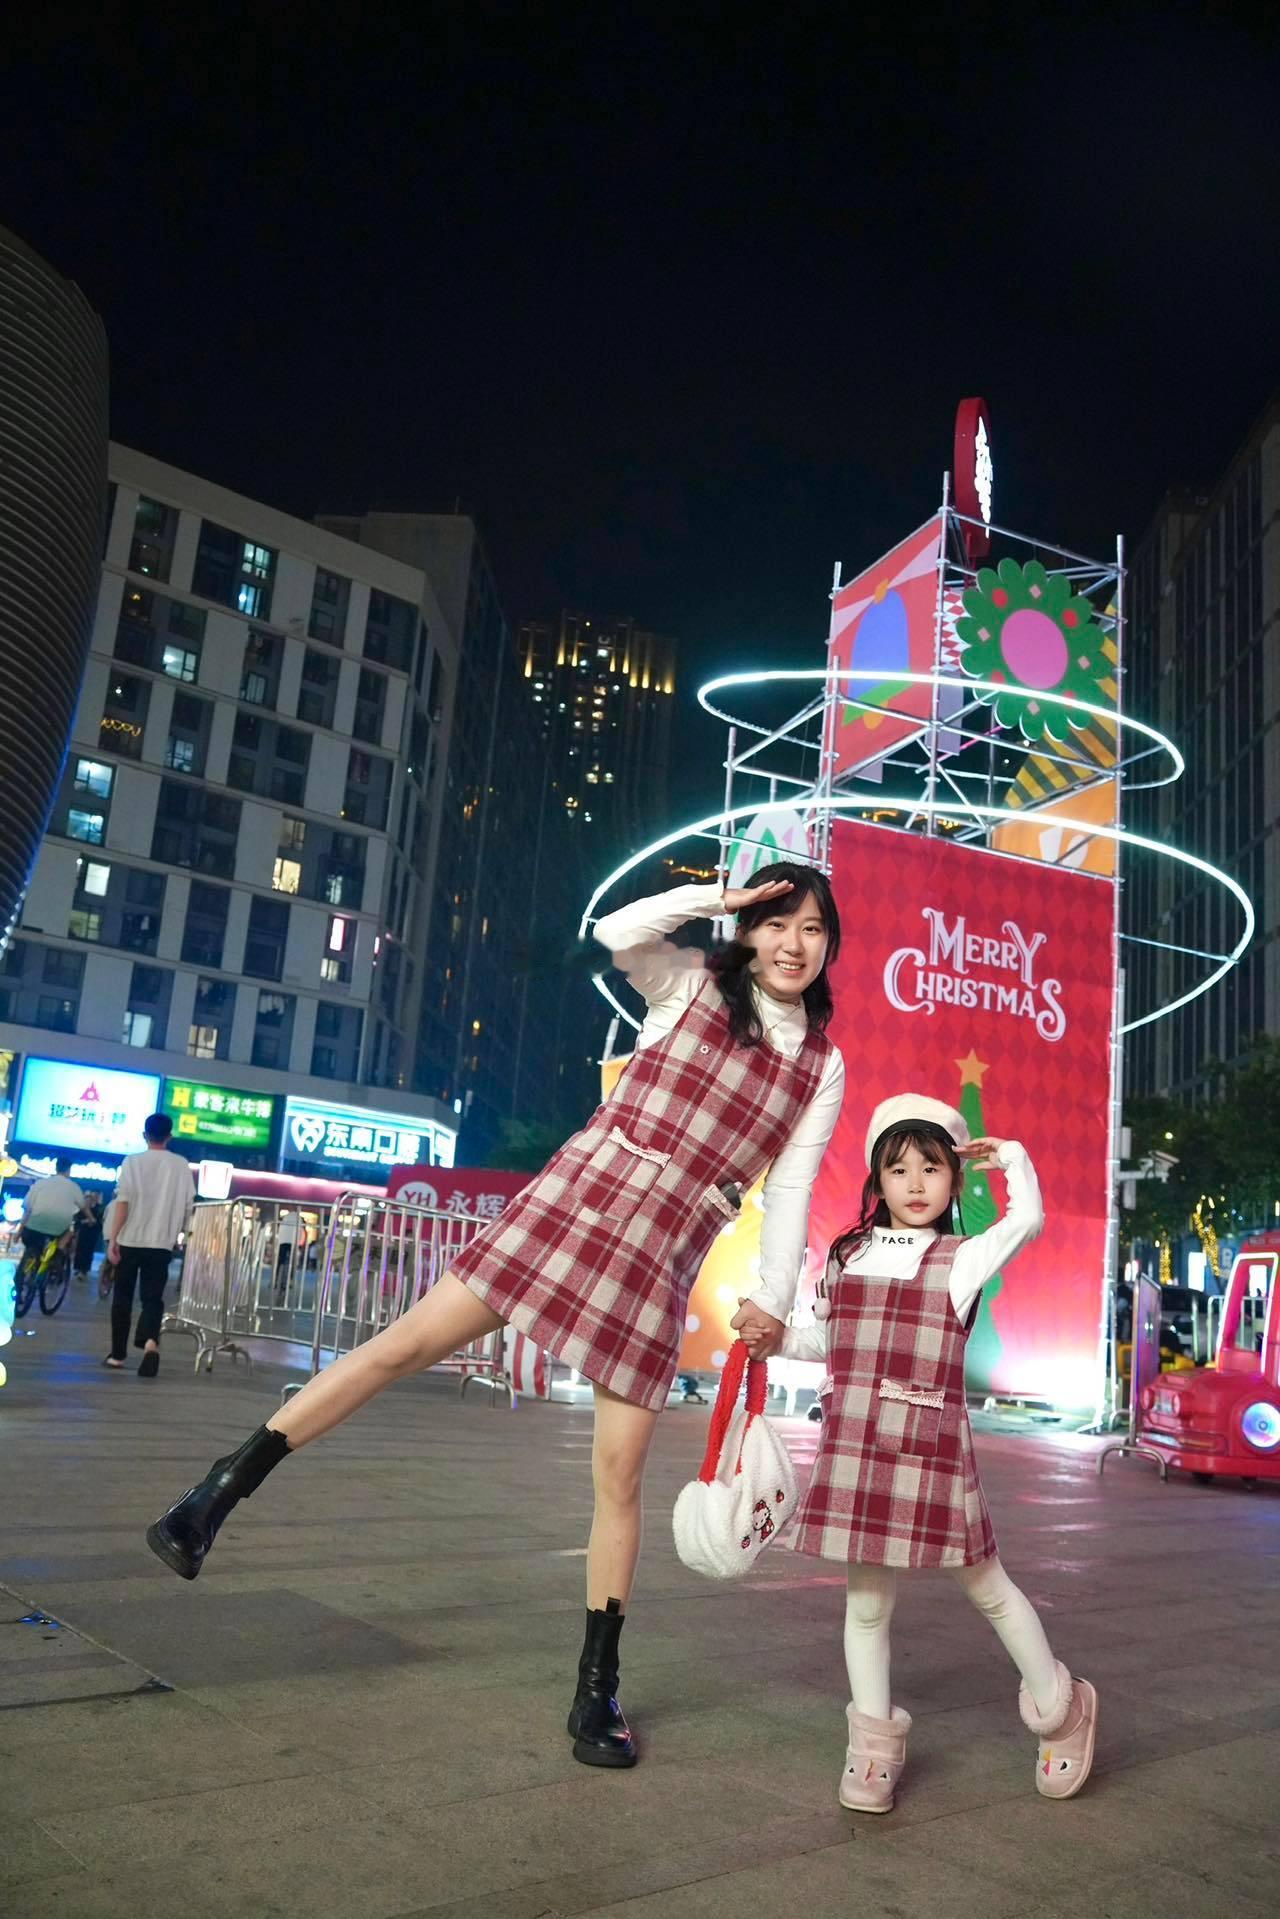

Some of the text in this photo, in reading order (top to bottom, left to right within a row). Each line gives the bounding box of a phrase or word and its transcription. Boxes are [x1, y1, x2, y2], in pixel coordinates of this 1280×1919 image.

[922, 907, 1047, 989] MERRY
[883, 947, 1066, 1042] CHRISTMAS
[445, 1188, 506, 1219] 永辉
[881, 1236, 914, 1245] FACE
